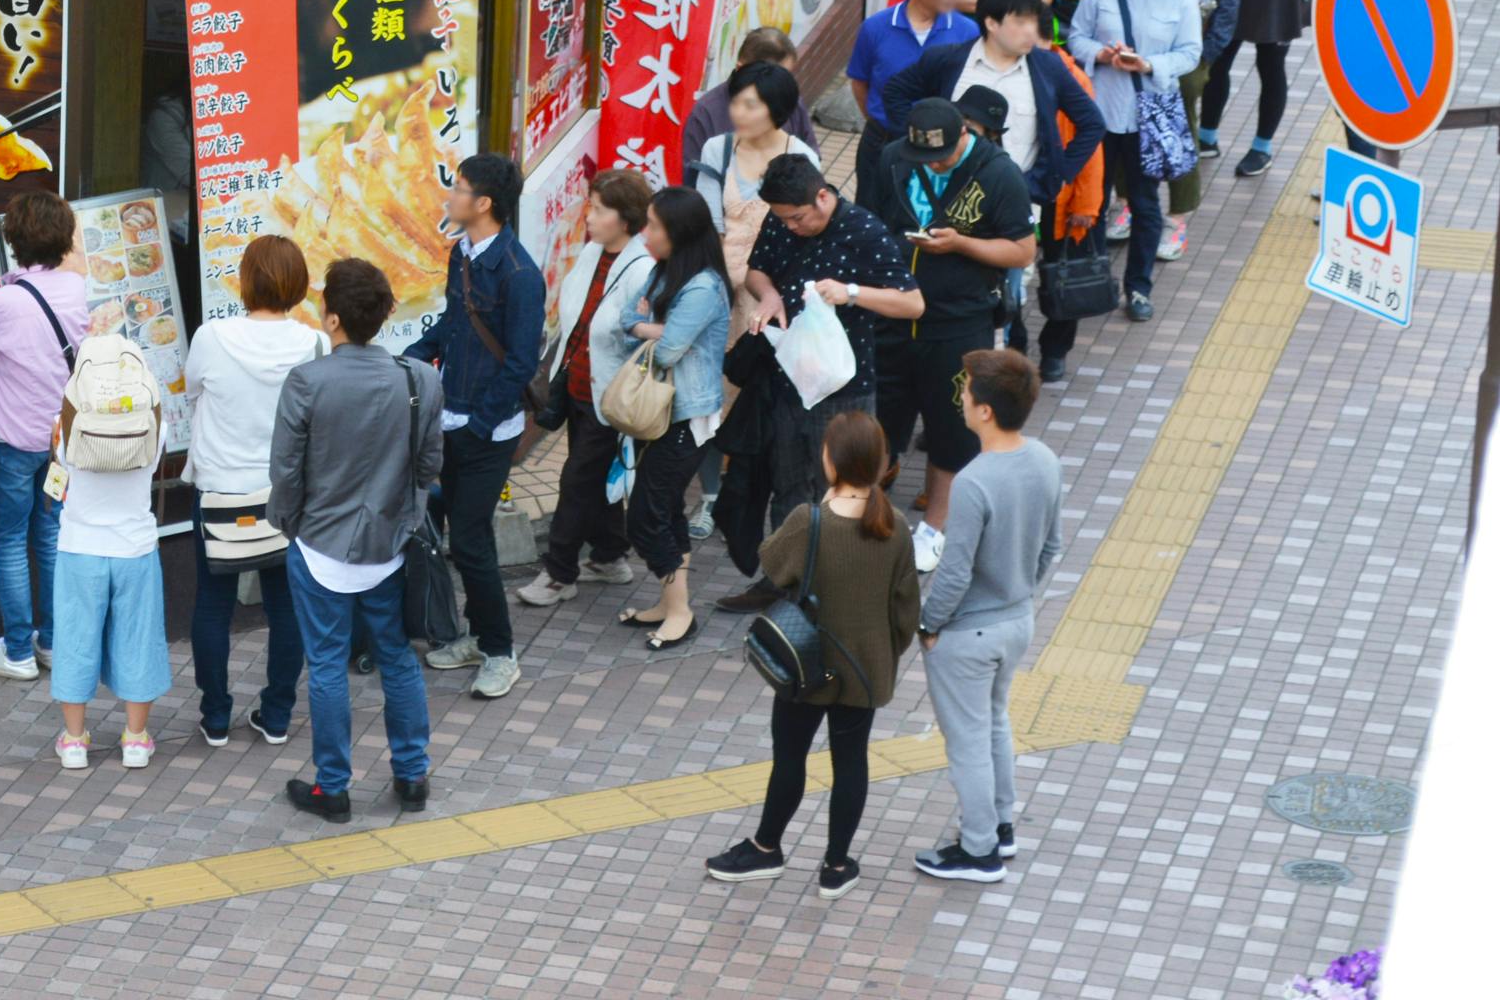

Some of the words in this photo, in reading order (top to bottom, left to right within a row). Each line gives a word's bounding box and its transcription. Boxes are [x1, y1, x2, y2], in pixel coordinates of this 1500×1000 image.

[192, 12, 243, 34] ニラ餃子
[194, 52, 246, 76] お肉餃子
[196, 93, 249, 118] 激辛餃子
[198, 135, 243, 158] シソ餃子
[201, 171, 283, 198] どんこ椎茸餃子
[204, 215, 263, 237] チーズ餃子
[206, 264, 238, 279] ニンニ
[1331, 237, 1402, 284] ここから
[1324, 260, 1400, 311] 車輪止め
